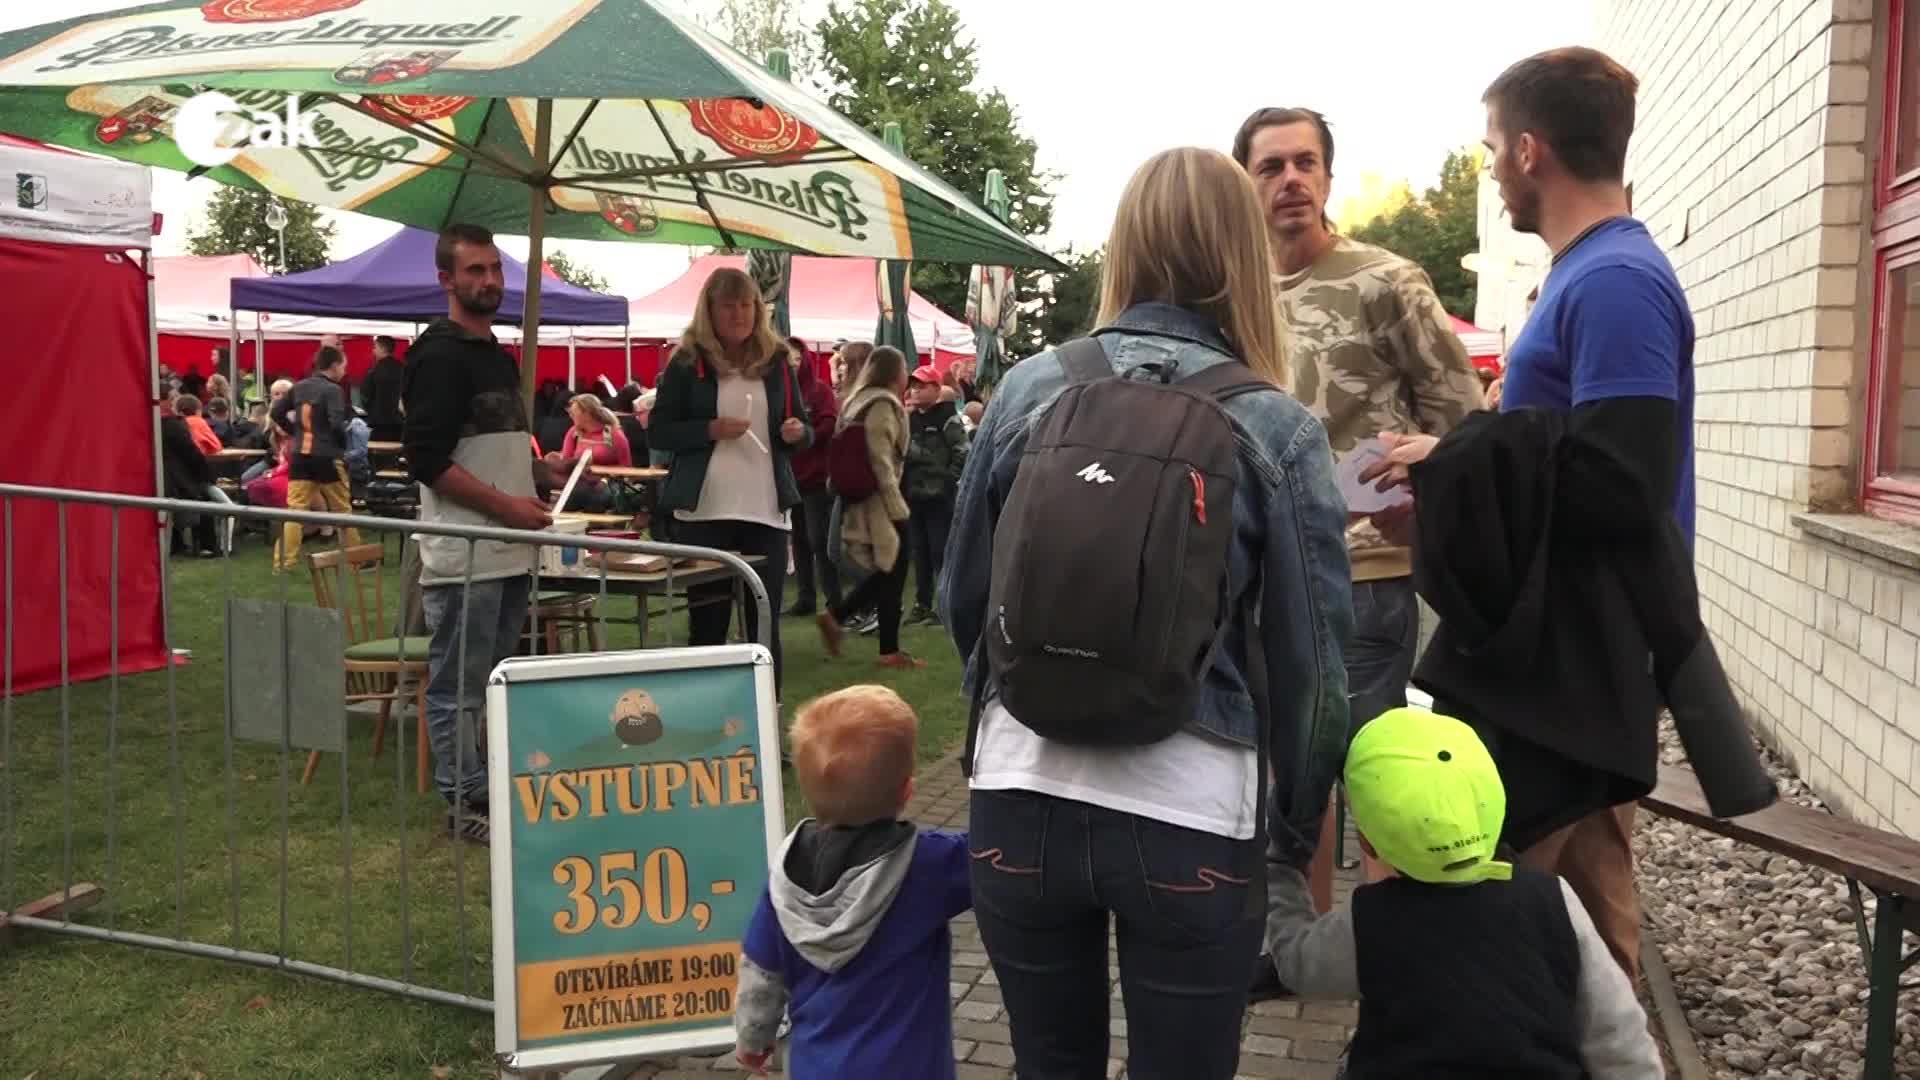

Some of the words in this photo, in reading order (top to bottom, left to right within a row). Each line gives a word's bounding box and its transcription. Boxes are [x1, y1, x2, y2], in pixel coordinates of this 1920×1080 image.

[34, 24, 300, 73] Pilsner
[297, 14, 522, 49] Urquell
[512, 745, 760, 824] VSTUPNÉ
[552, 846, 737, 935] 350,-
[554, 957, 674, 996] OTEVÍRÁME
[680, 951, 736, 982] 19:00
[562, 992, 667, 1031] ZAČÍNÁME
[671, 986, 731, 1019] 20:00
